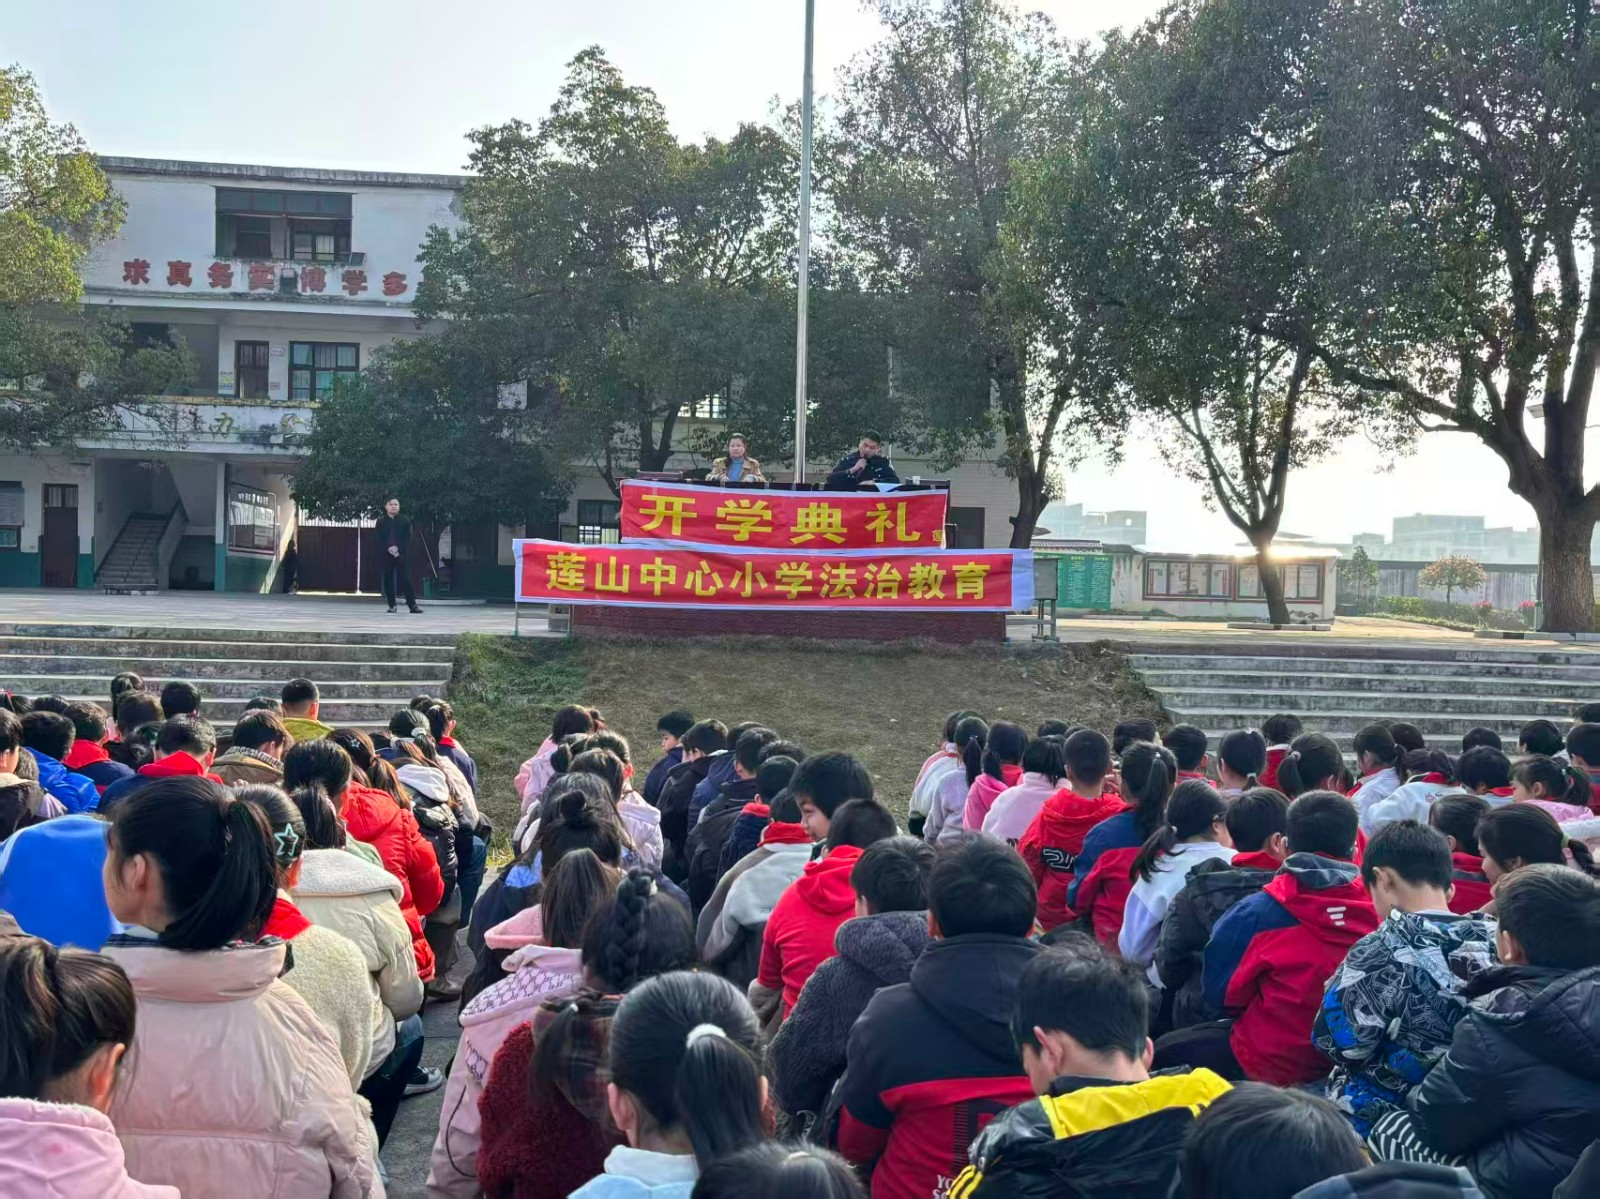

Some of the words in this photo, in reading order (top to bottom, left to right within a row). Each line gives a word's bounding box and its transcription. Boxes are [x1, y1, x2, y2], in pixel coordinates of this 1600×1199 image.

[638, 494, 921, 545] 开学典礼
[545, 551, 992, 601] 莲山中心小学法治教育
